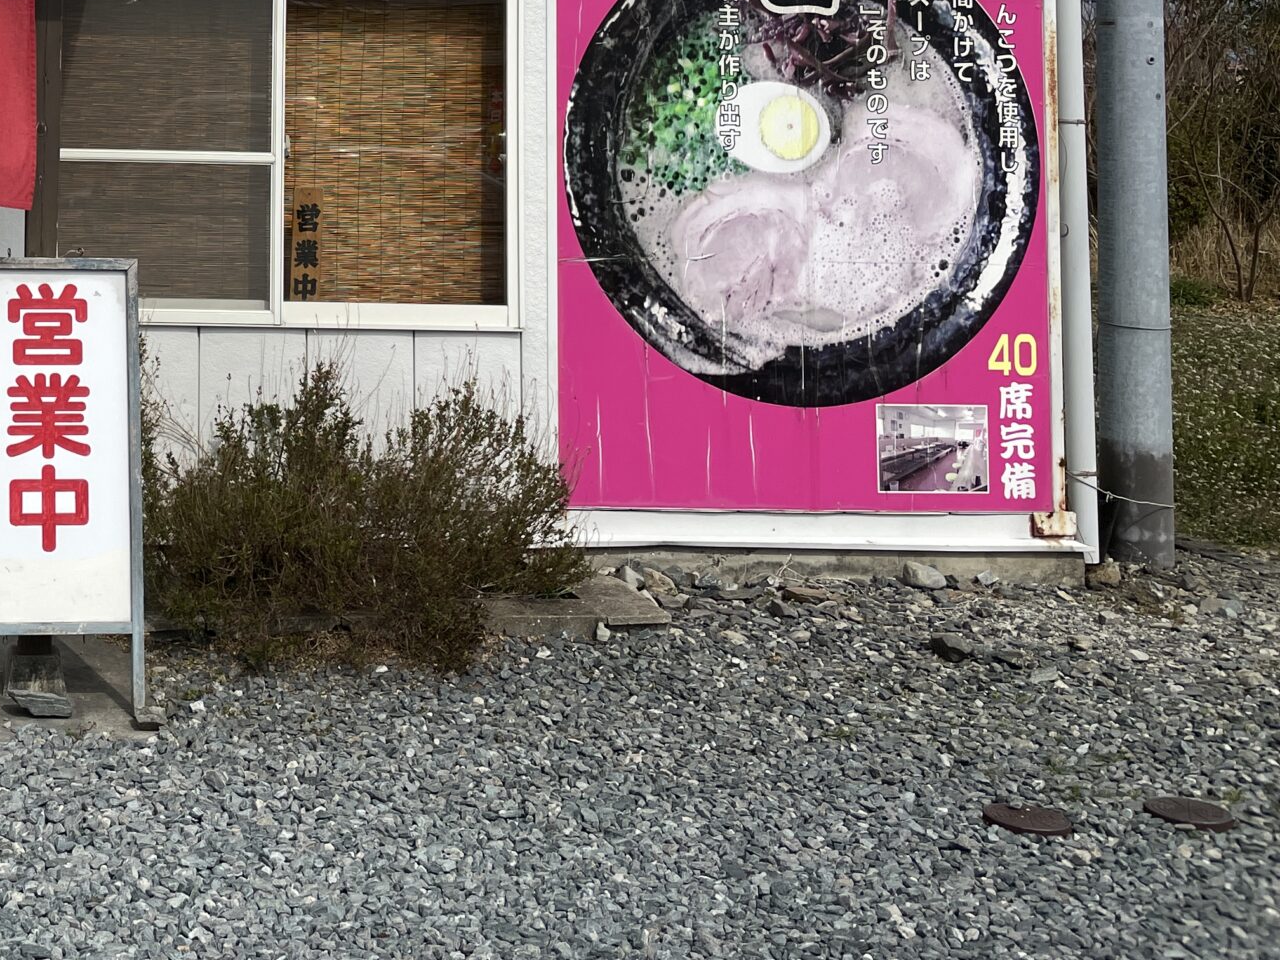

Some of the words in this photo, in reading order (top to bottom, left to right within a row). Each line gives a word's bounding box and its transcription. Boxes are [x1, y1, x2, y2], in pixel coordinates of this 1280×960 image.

[294, 202, 321, 300] 営業中
[6, 283, 91, 552] 営業中
